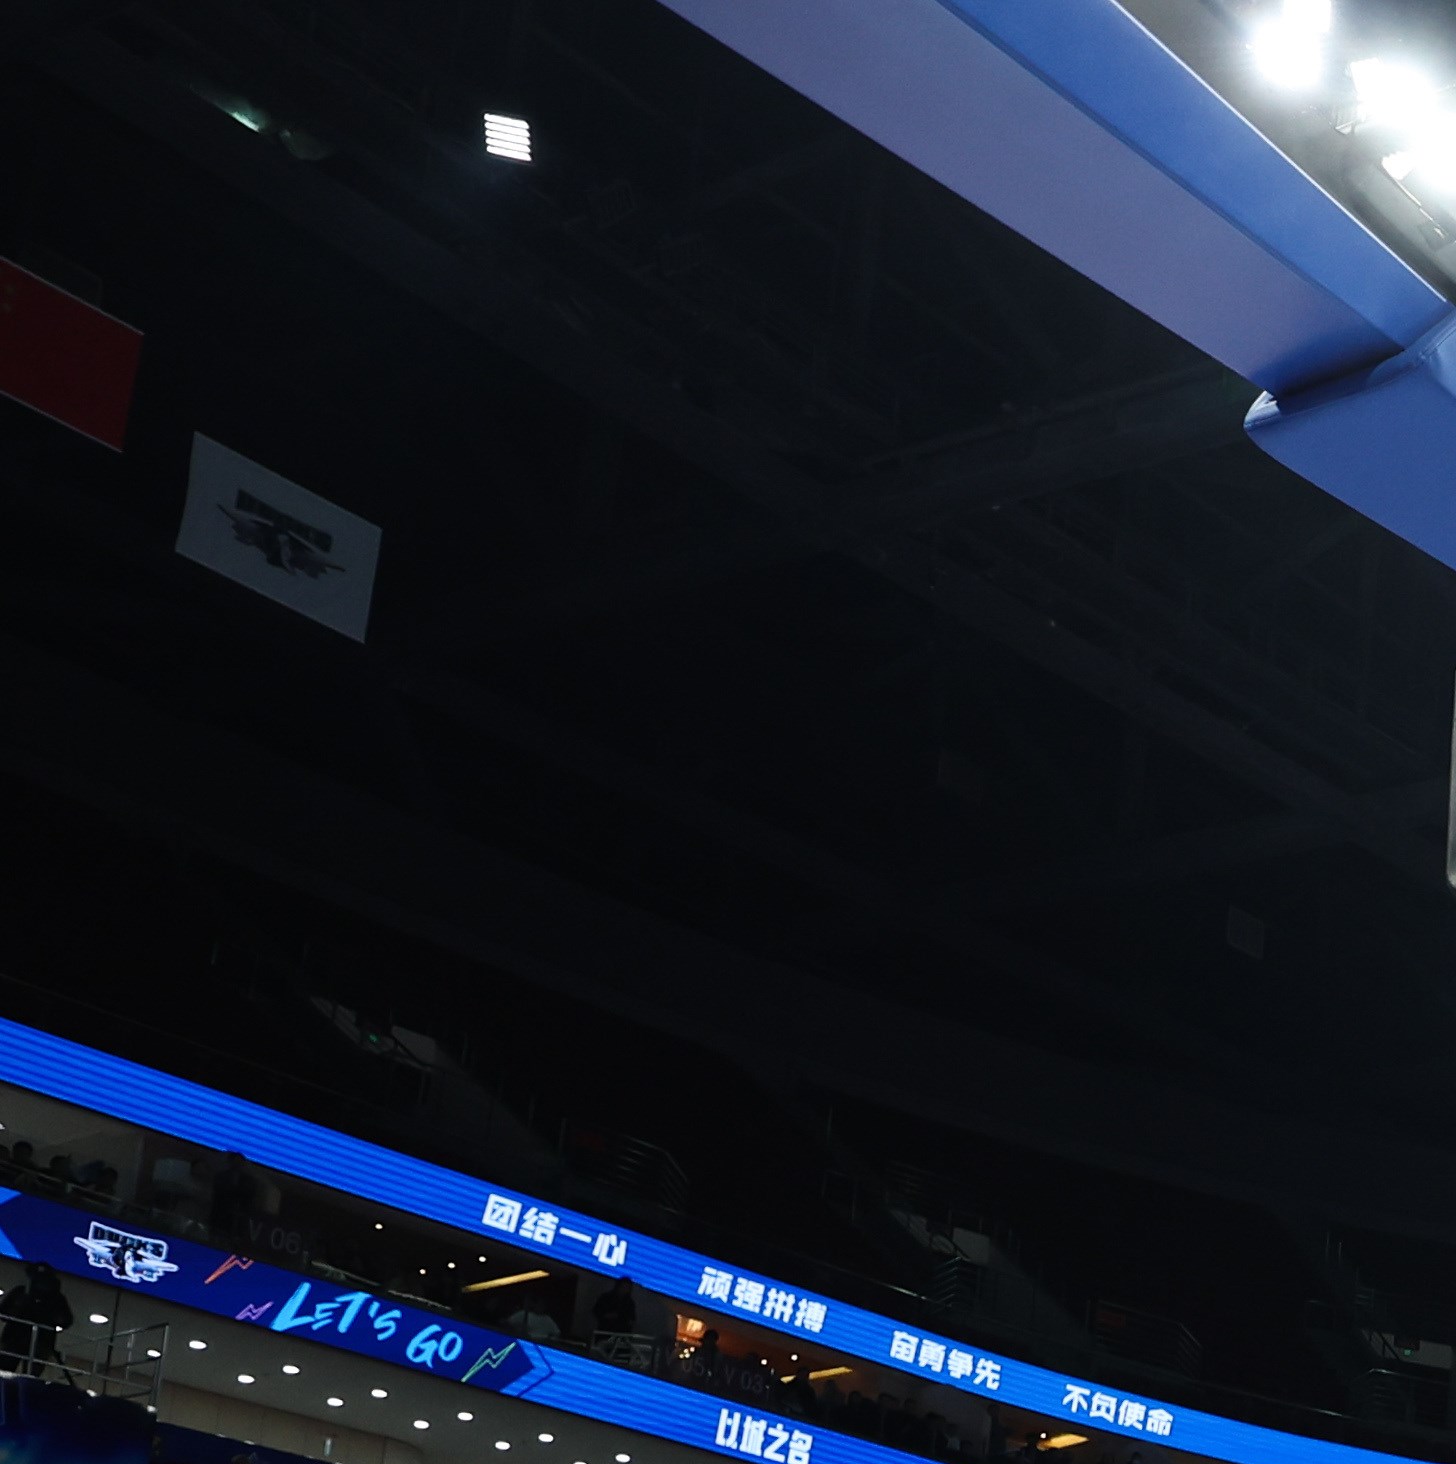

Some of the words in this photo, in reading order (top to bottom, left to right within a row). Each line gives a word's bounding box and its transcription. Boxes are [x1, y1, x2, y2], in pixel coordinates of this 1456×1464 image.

[481, 1193, 628, 1268] 团结一心
[268, 1281, 402, 1341] LET'S
[405, 1323, 465, 1369] GO
[696, 1266, 829, 1334] 顽强拼搏
[889, 1330, 1002, 1391] 奋勇争先
[1062, 1382, 1175, 1438] 不负使命
